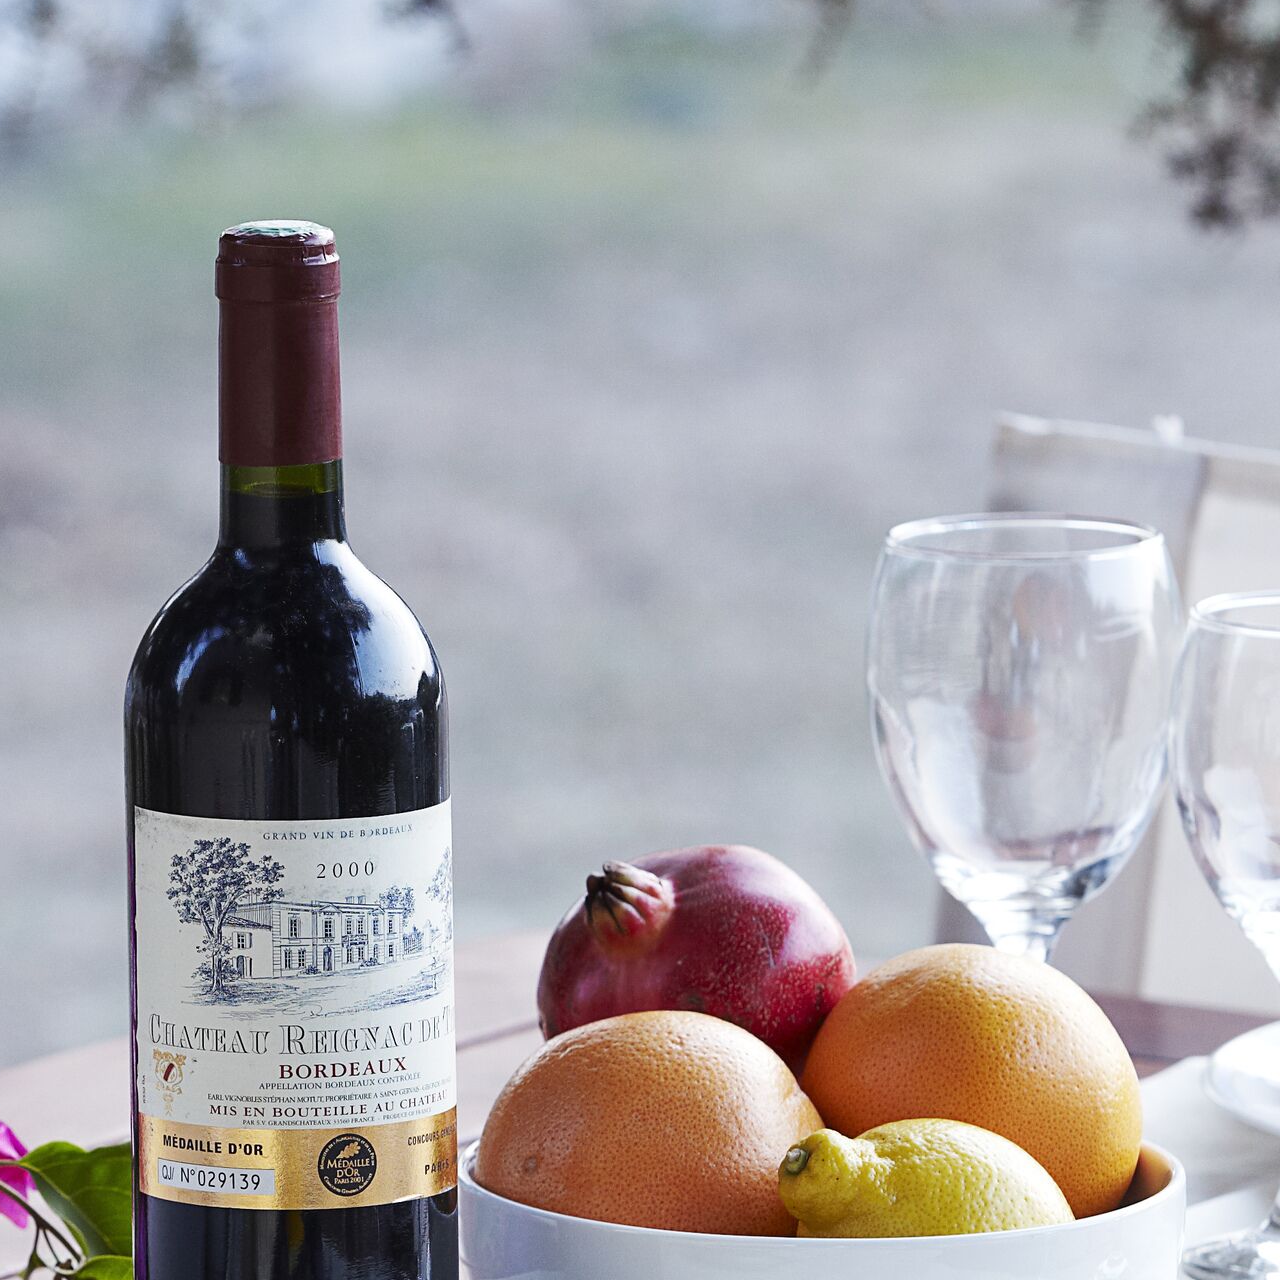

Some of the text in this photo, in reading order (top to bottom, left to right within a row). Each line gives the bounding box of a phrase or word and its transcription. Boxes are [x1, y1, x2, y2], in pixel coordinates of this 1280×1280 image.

[263, 832, 307, 841] GRAND
[313, 831, 334, 840] VIN
[340, 830, 354, 839] DE
[317, 861, 374, 879] 2000
[149, 1013, 271, 1055] CHATEAU
[279, 1022, 413, 1056] REIGNAC
[280, 1057, 407, 1080] BORDEAUX
[259, 1082, 322, 1091] APPELLATION
[325, 1078, 375, 1089] BORDEAUX
[210, 1089, 448, 1118] MIS EN BOUTEILLE AU CHATEAU
[163, 1133, 263, 1156] MÉDAILLE D'OR
[407, 1130, 439, 1146] CONCOURS
[327, 1158, 370, 1169] MÉDAILLE
[424, 1158, 450, 1175] PARIS
